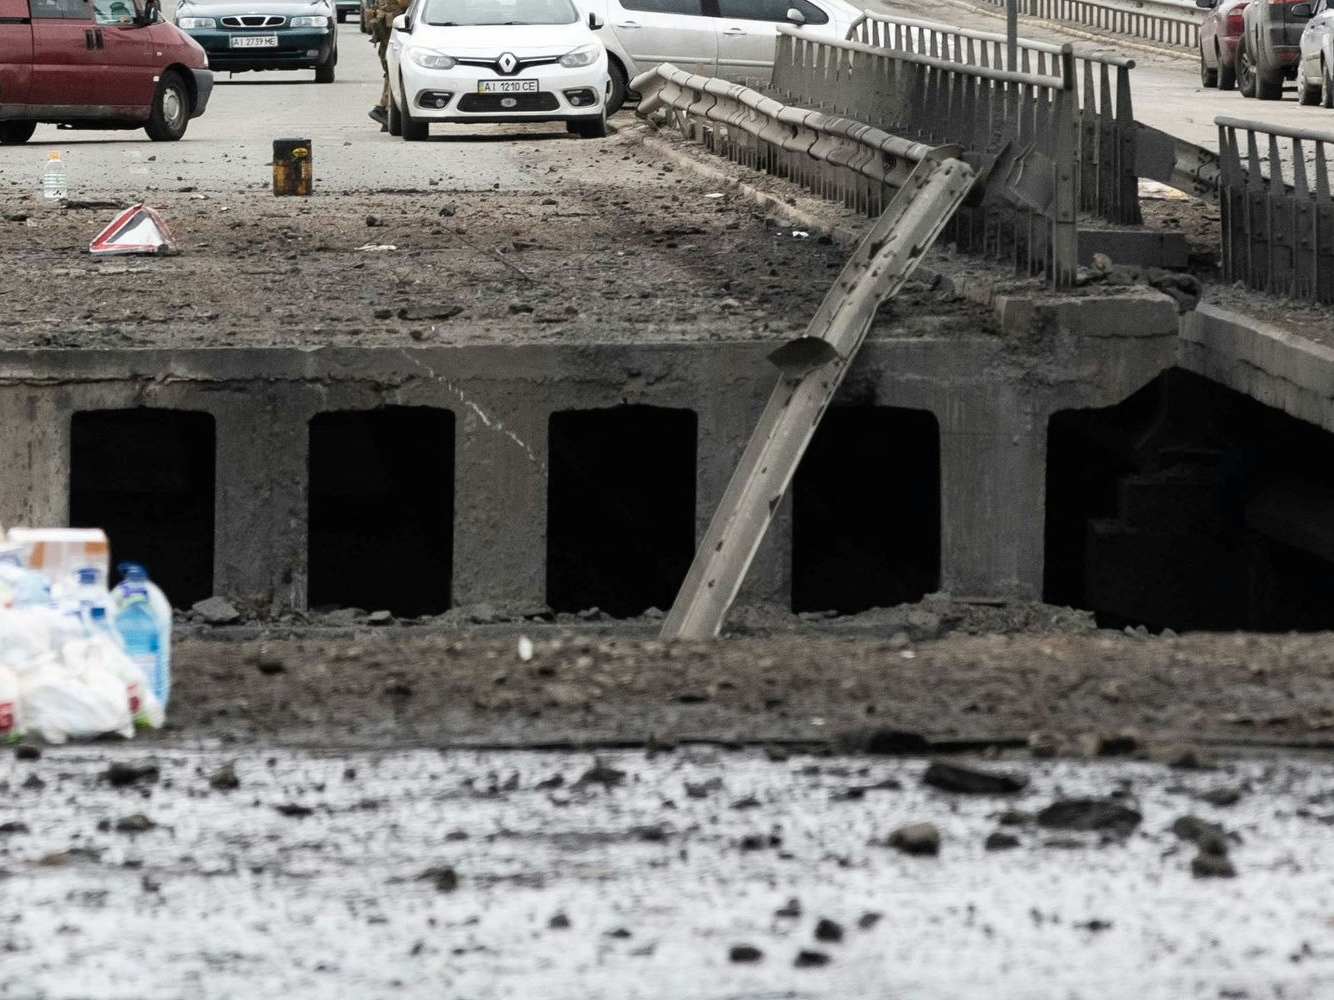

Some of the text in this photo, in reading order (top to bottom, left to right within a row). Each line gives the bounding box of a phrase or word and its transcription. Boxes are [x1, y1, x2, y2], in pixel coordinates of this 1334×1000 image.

[485, 81, 536, 92] AI 1210 CE
